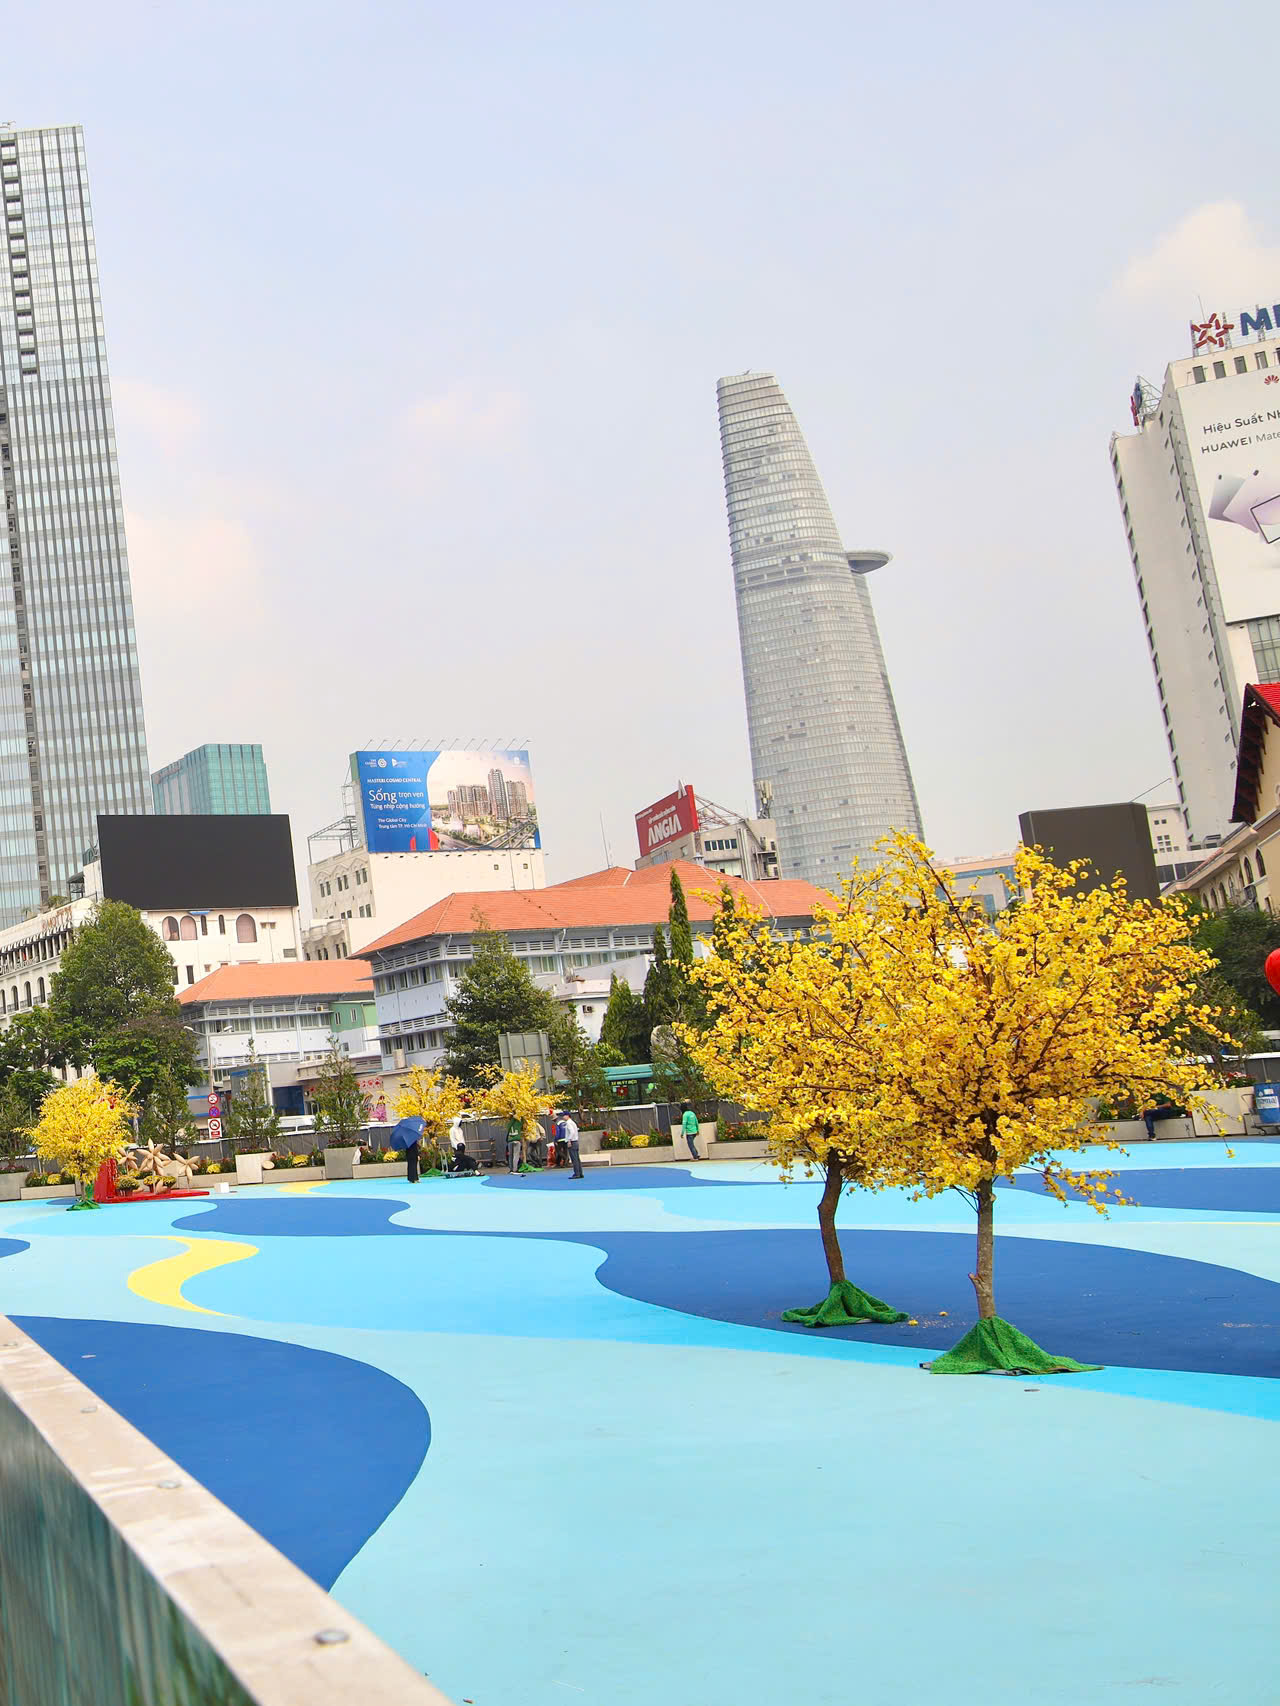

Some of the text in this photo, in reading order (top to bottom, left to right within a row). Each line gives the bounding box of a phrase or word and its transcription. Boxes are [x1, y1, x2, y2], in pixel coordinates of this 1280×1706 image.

[1203, 422, 1231, 435] Hiệu
[1234, 412, 1263, 428] Suất
[1201, 437, 1252, 454] HUAWEI
[368, 788, 397, 804] Sống
